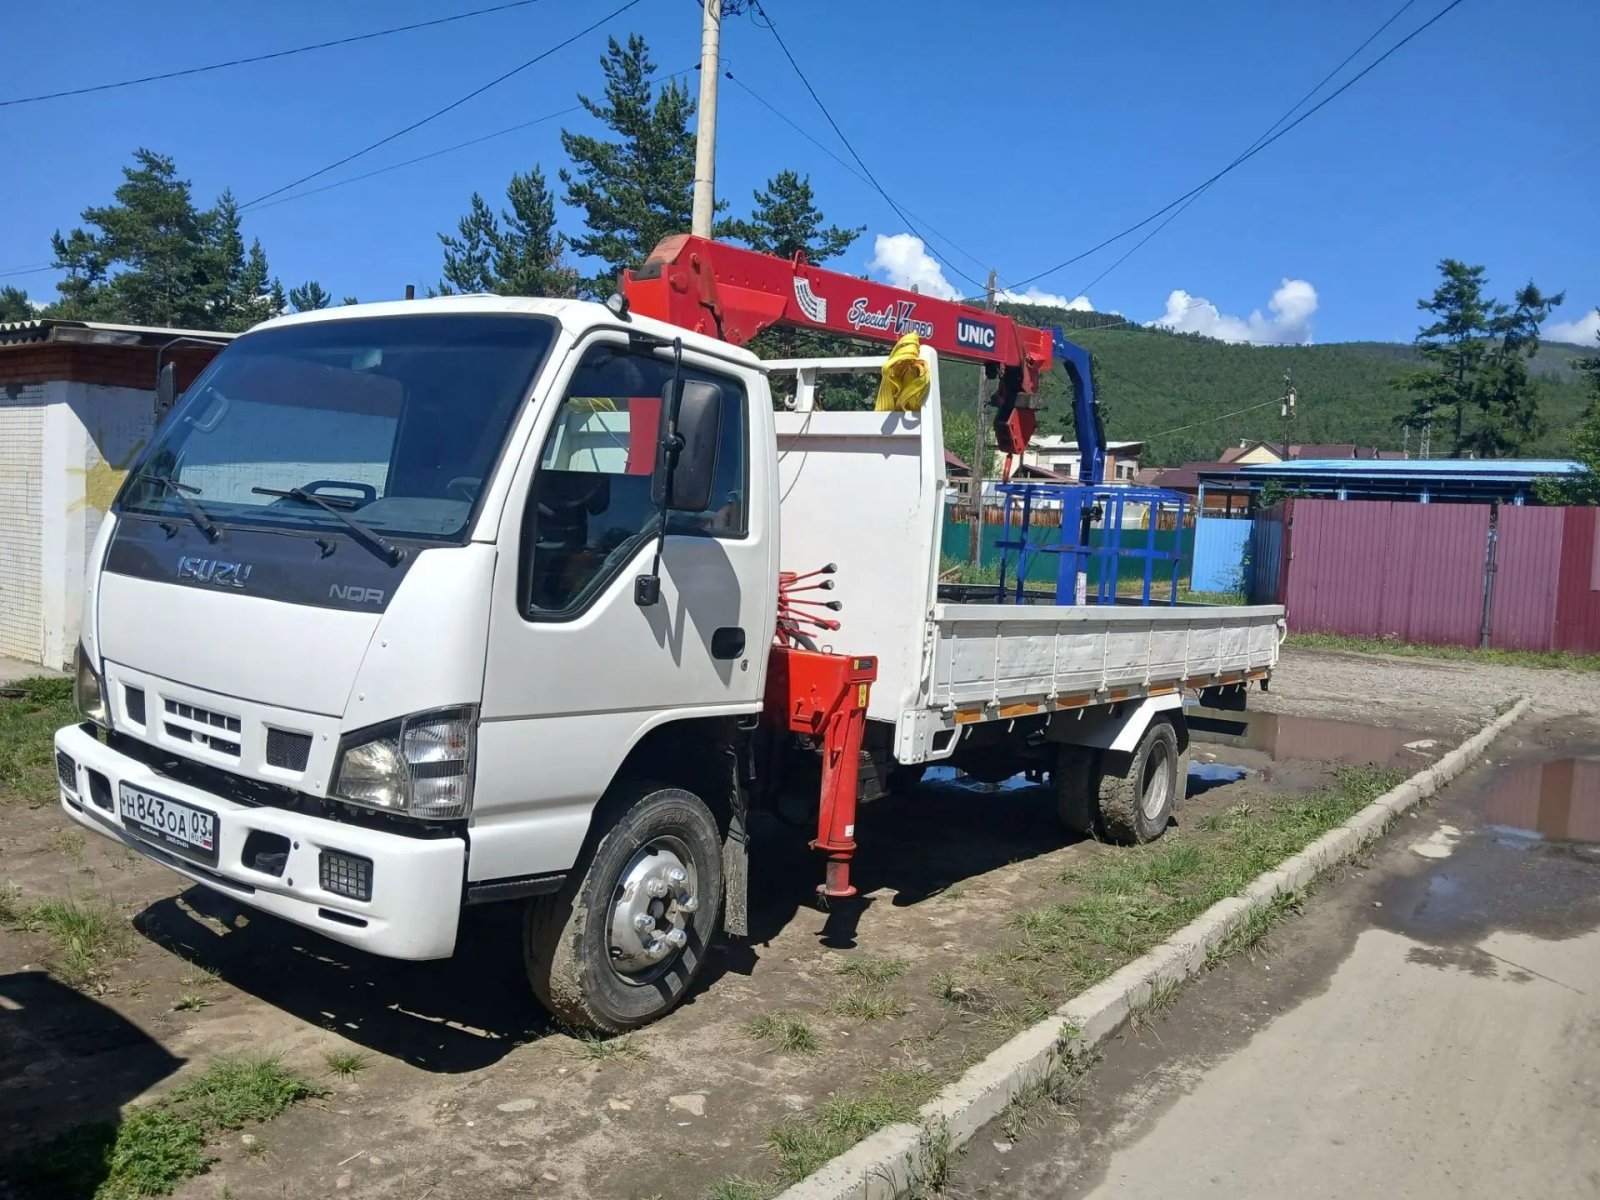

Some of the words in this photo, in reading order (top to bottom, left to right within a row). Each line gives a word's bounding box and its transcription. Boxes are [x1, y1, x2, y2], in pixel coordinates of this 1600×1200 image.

[902, 319, 933, 339] TURBO
[957, 324, 995, 347] UNIC
[177, 556, 252, 588] ISUZU
[329, 584, 384, 604] NQR
